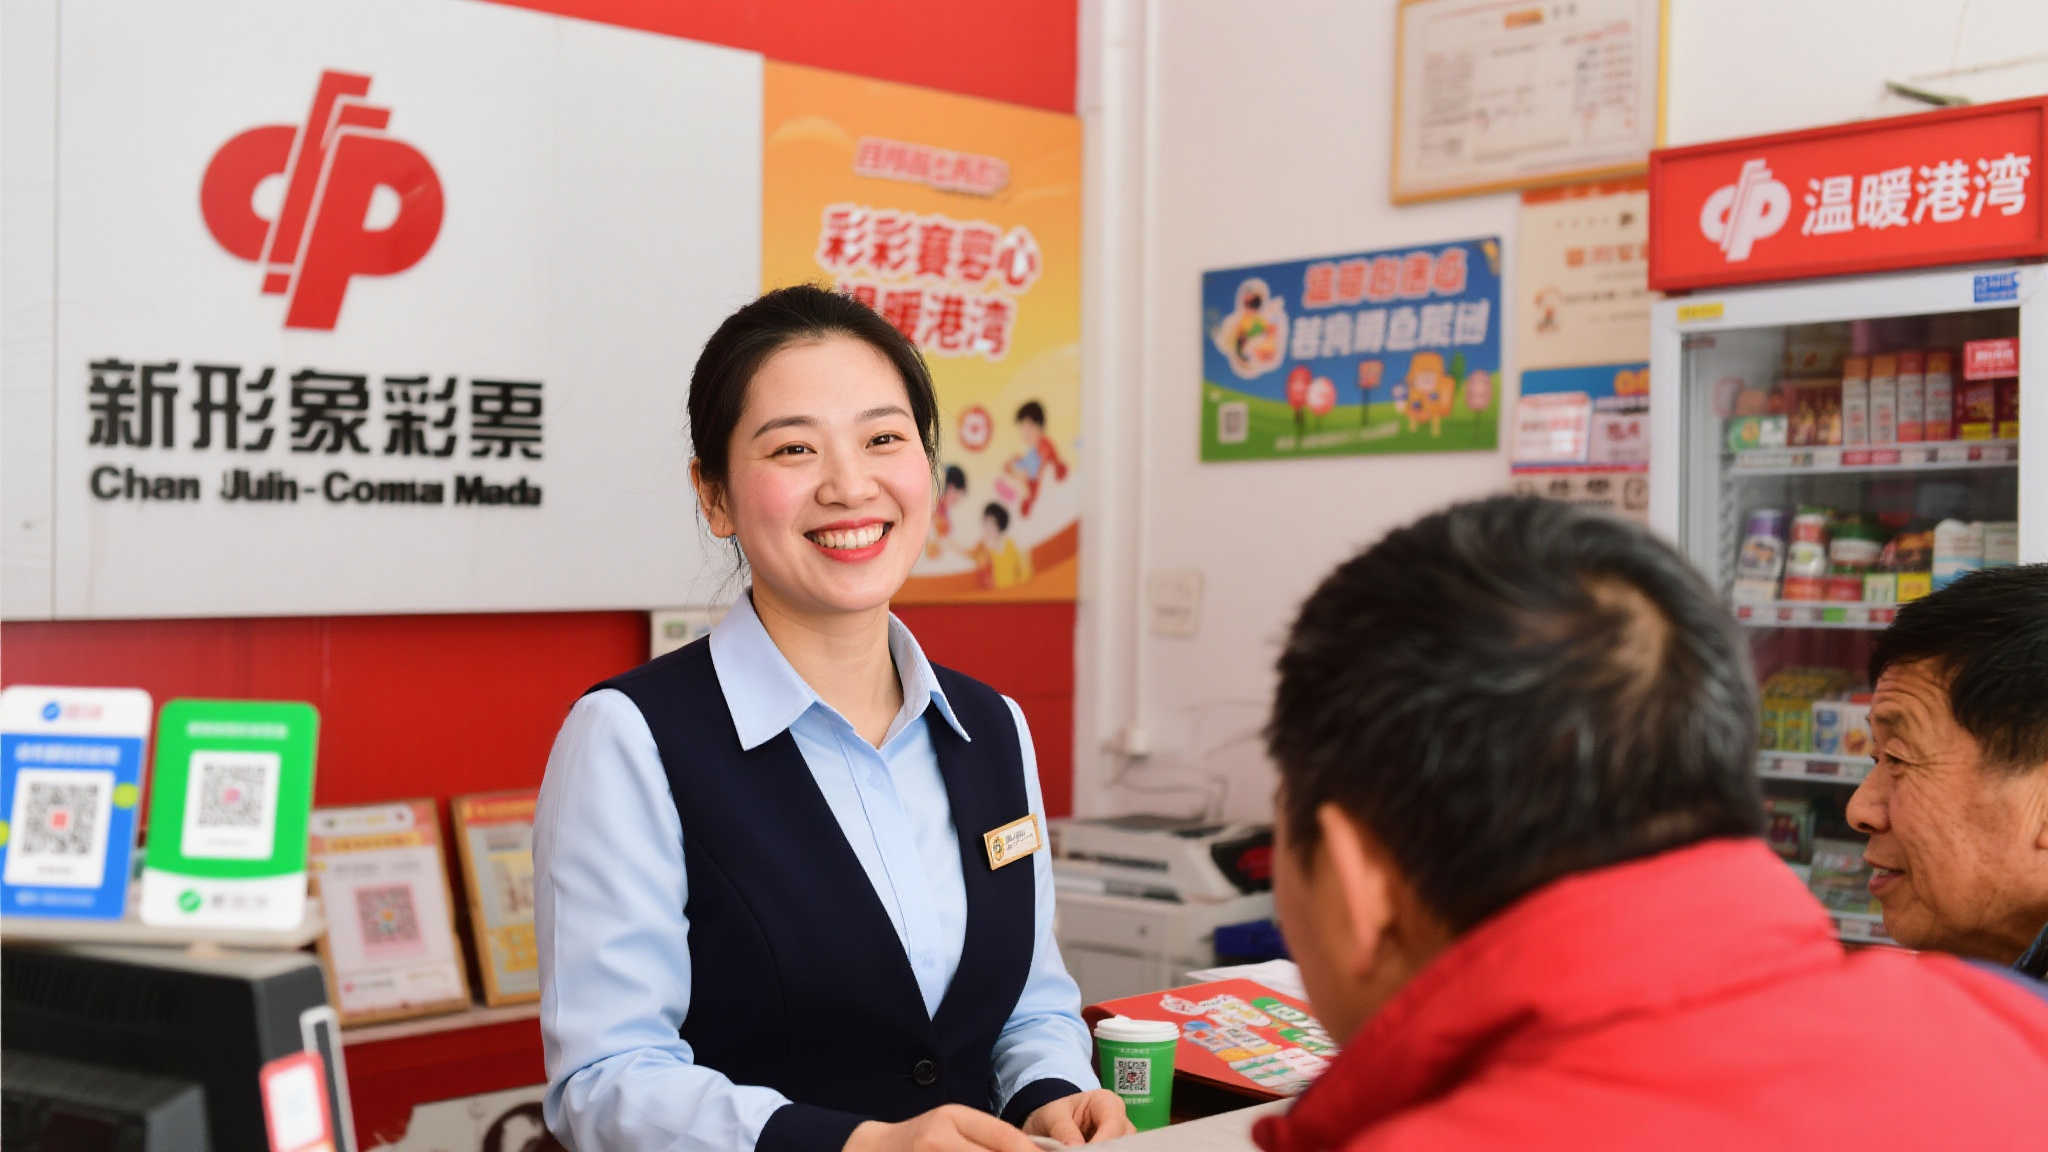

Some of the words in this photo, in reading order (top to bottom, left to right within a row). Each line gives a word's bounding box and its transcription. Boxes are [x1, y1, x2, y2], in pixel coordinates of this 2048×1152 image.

[1802, 153, 2031, 236] 温暖港湾
[87, 357, 545, 460] 新形象彩票
[89, 465, 201, 502] Chan
